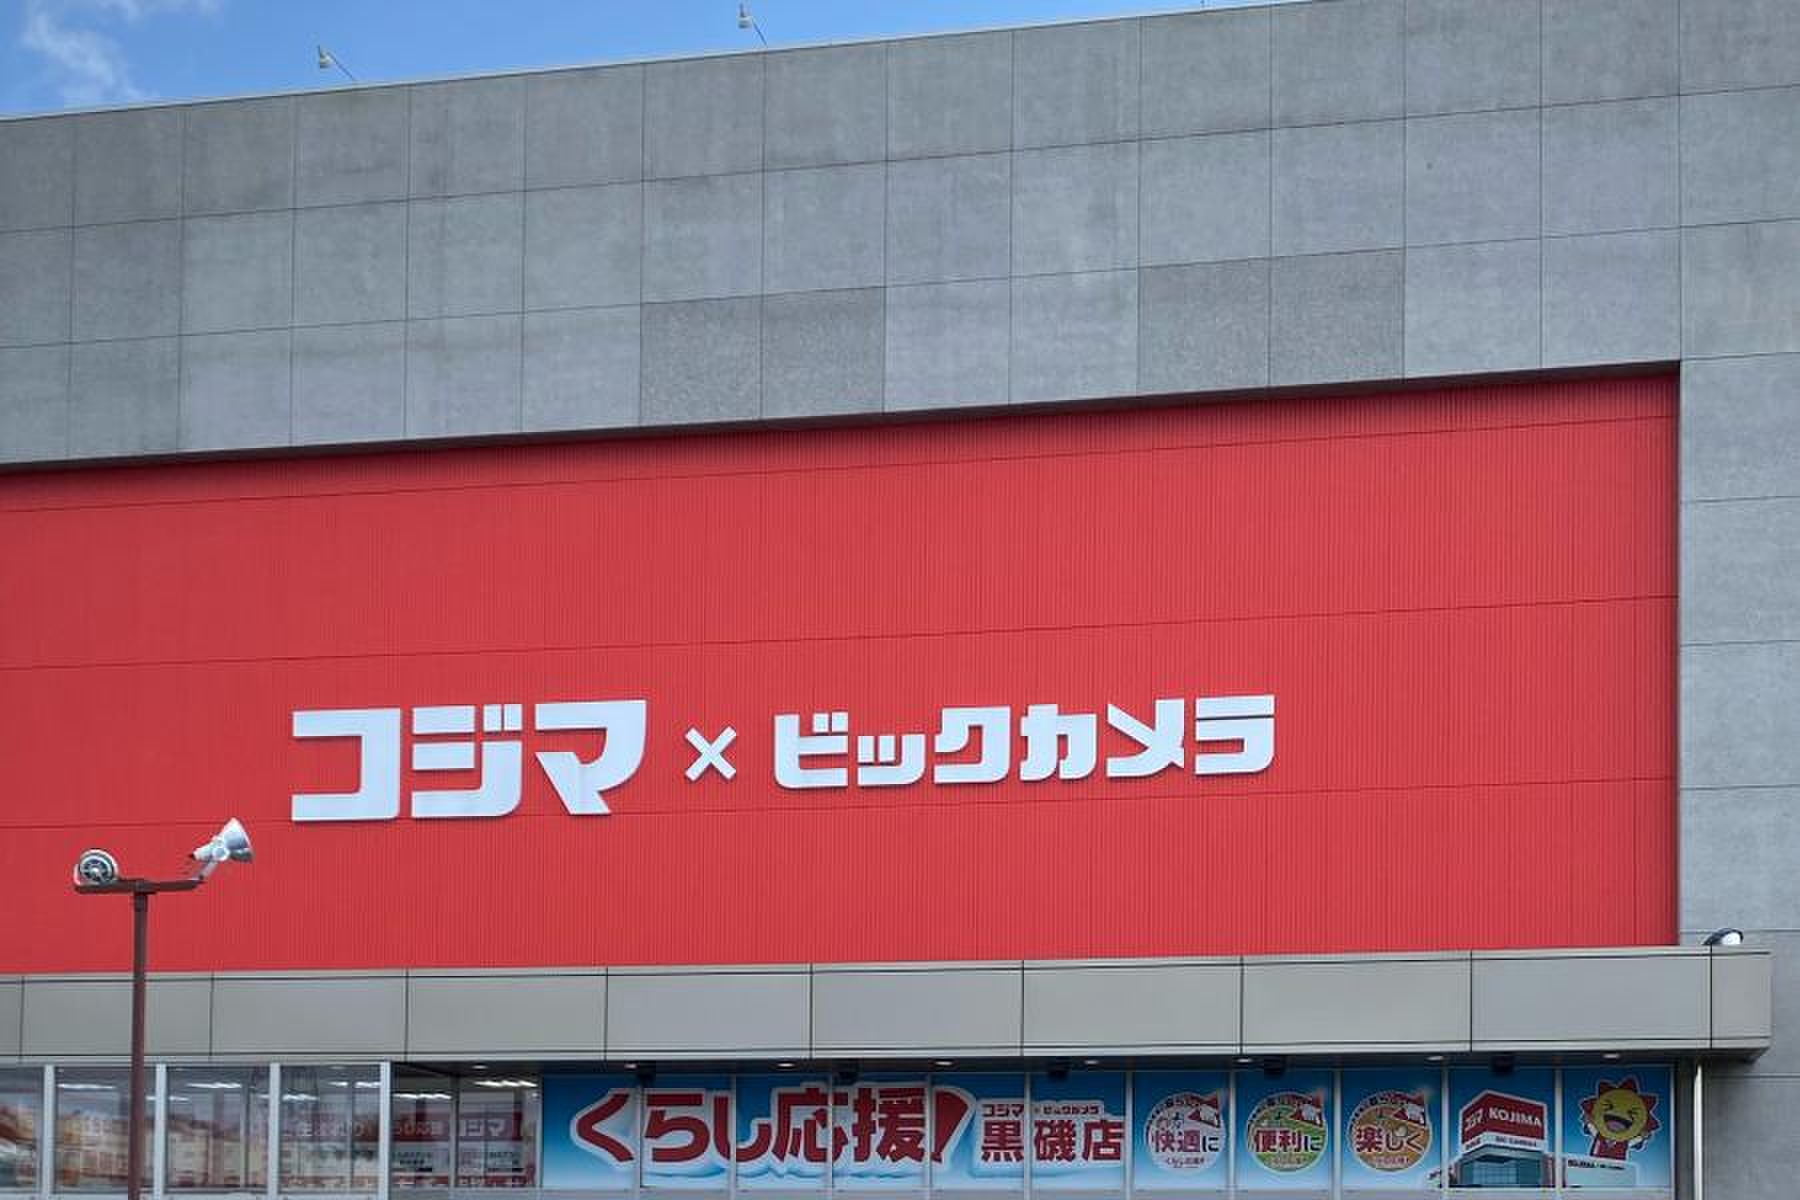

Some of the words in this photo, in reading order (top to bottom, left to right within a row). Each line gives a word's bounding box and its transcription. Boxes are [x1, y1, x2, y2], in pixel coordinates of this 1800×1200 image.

[291, 699, 648, 822] コジマ
[773, 694, 1276, 790] ビックカメラ
[1488, 1107, 1542, 1127] KOJIMA
[981, 1119, 1127, 1162] 黒磯店
[1154, 1129, 1220, 1153] 快適に
[1254, 1129, 1324, 1153] 便利に
[1355, 1126, 1424, 1153] 楽しく
